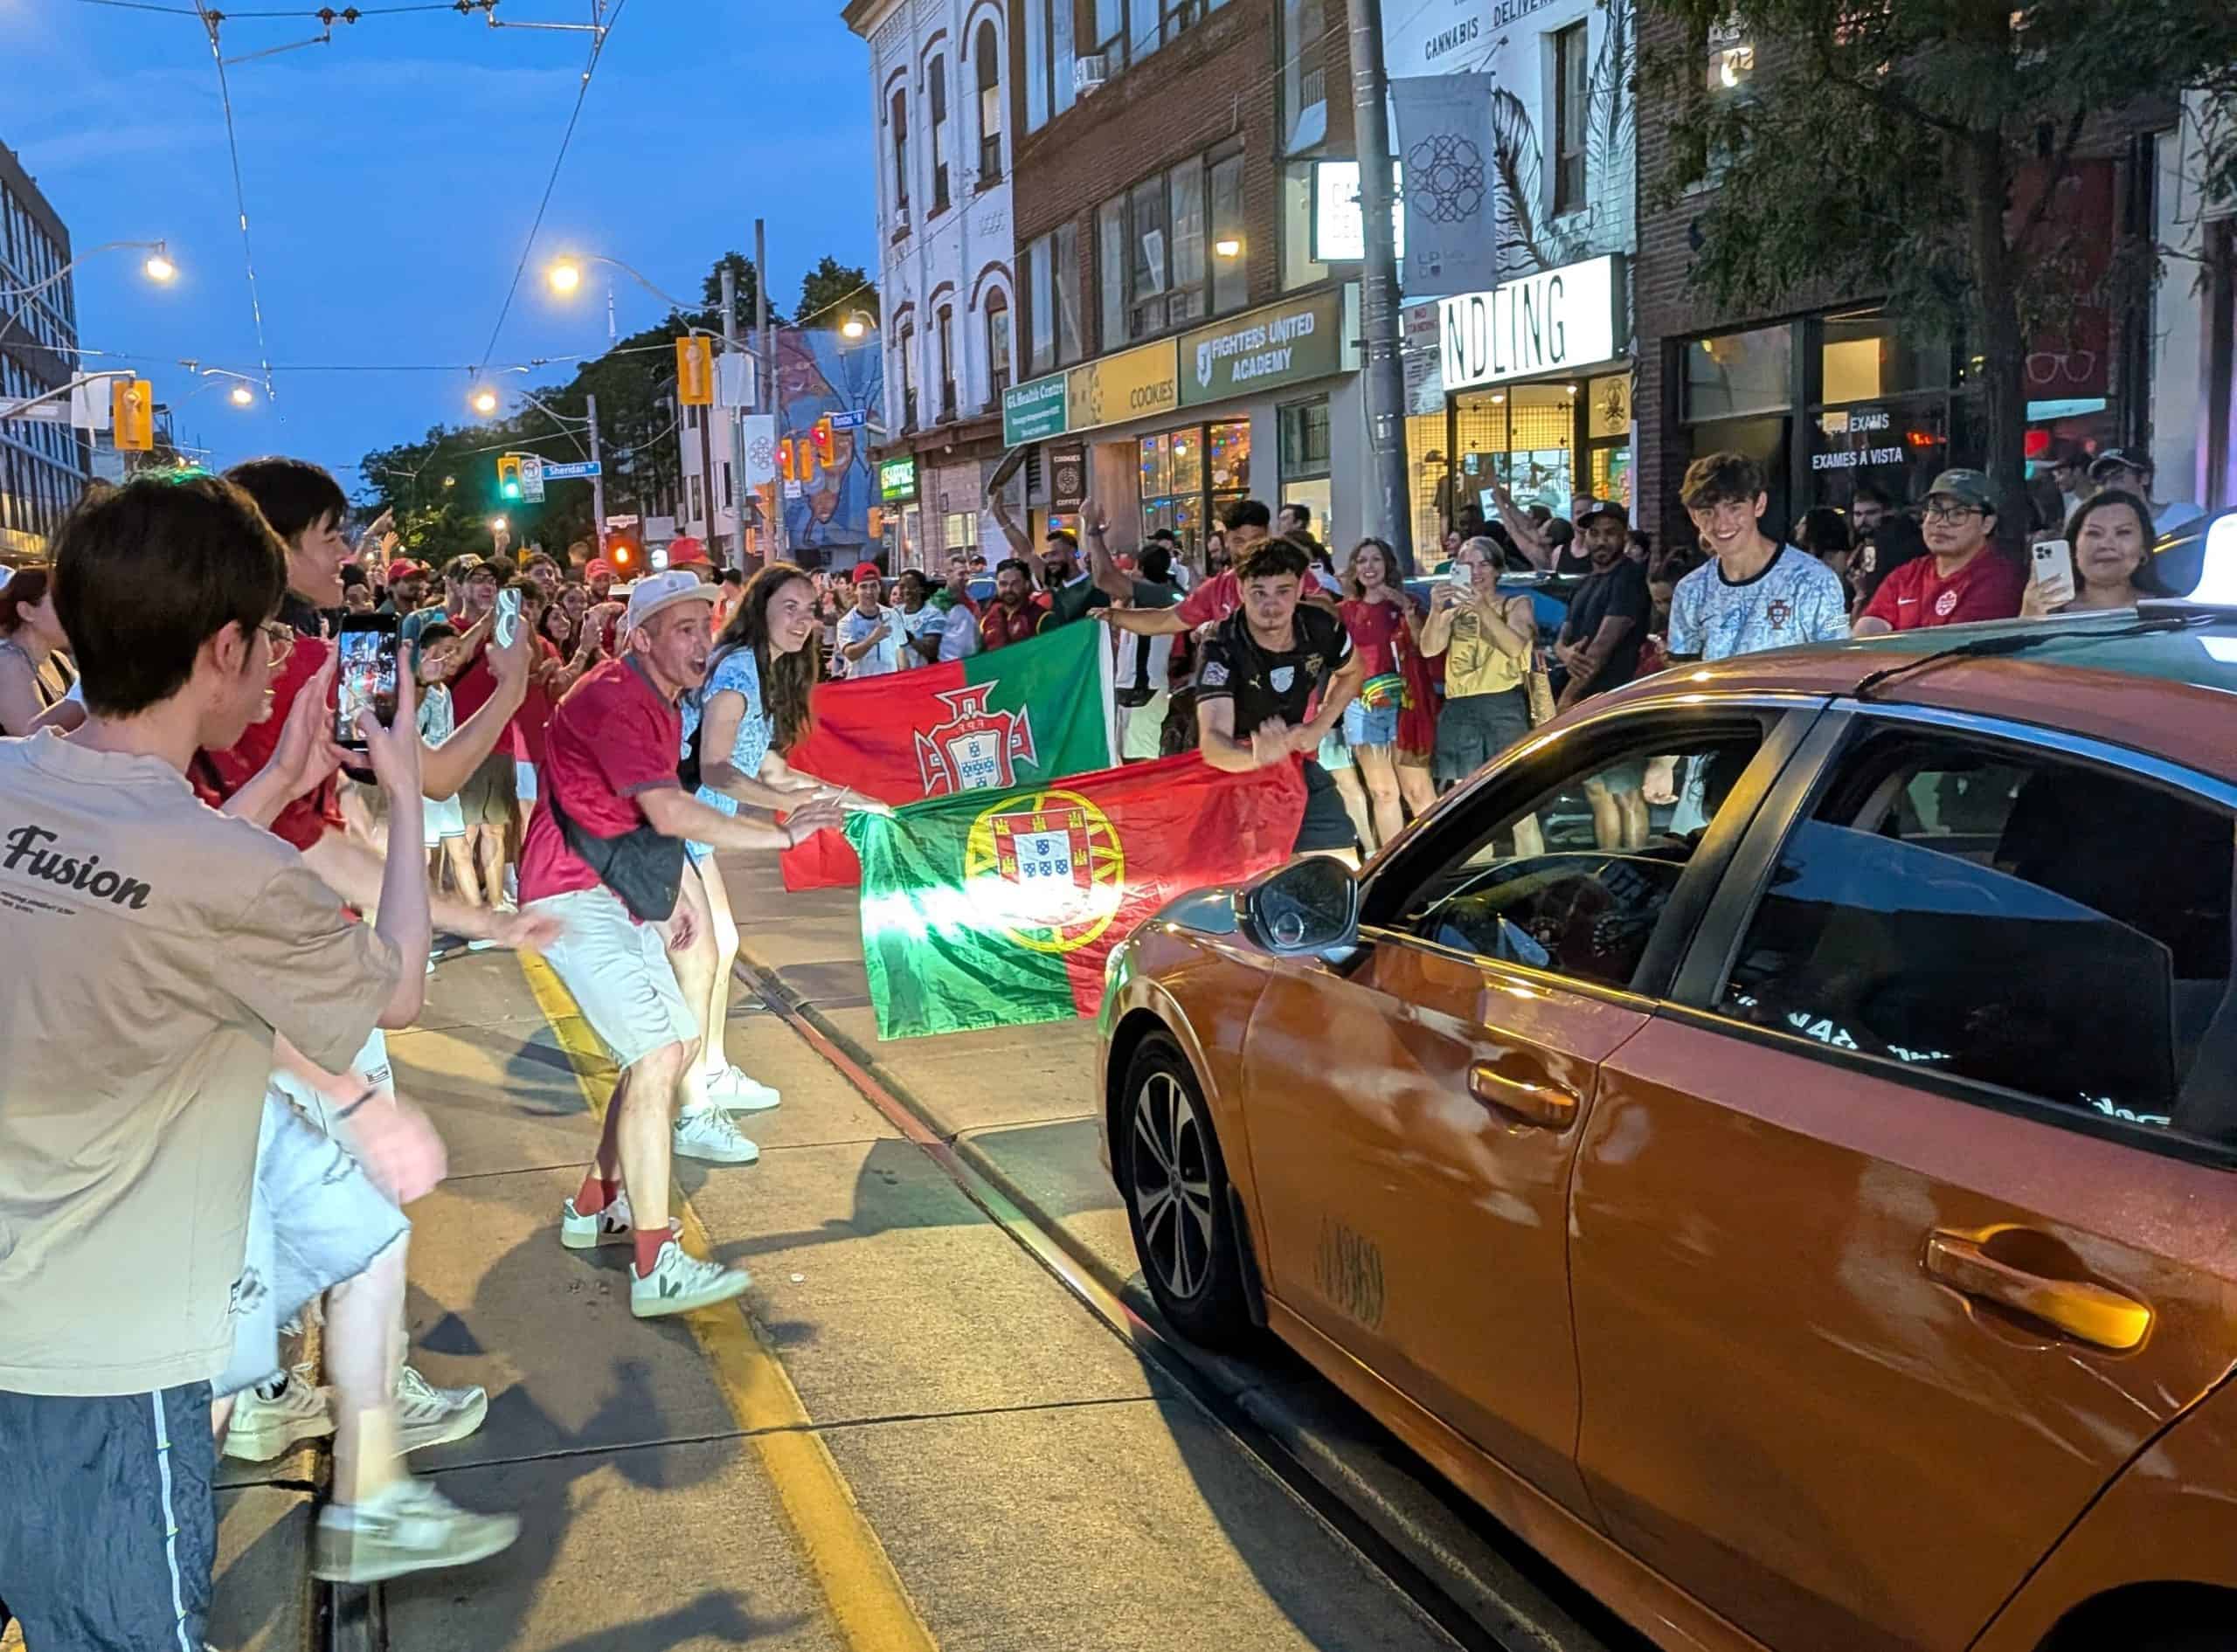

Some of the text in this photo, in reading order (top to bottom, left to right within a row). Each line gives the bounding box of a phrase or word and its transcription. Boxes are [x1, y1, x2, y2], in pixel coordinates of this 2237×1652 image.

[1424, 0, 1555, 60] CANNABIS DELIV
[1212, 312, 1314, 359] FIGHTERS UNITED
[1231, 347, 1292, 383] ACADEMY
[1130, 379, 1174, 409] COOKIES
[1849, 413, 1889, 432] EXAMS
[549, 464, 586, 475] Sheridan
[1811, 451, 1857, 470] EXAMES
[1870, 446, 1903, 466] VISTA
[3, 824, 152, 910] Fusion
